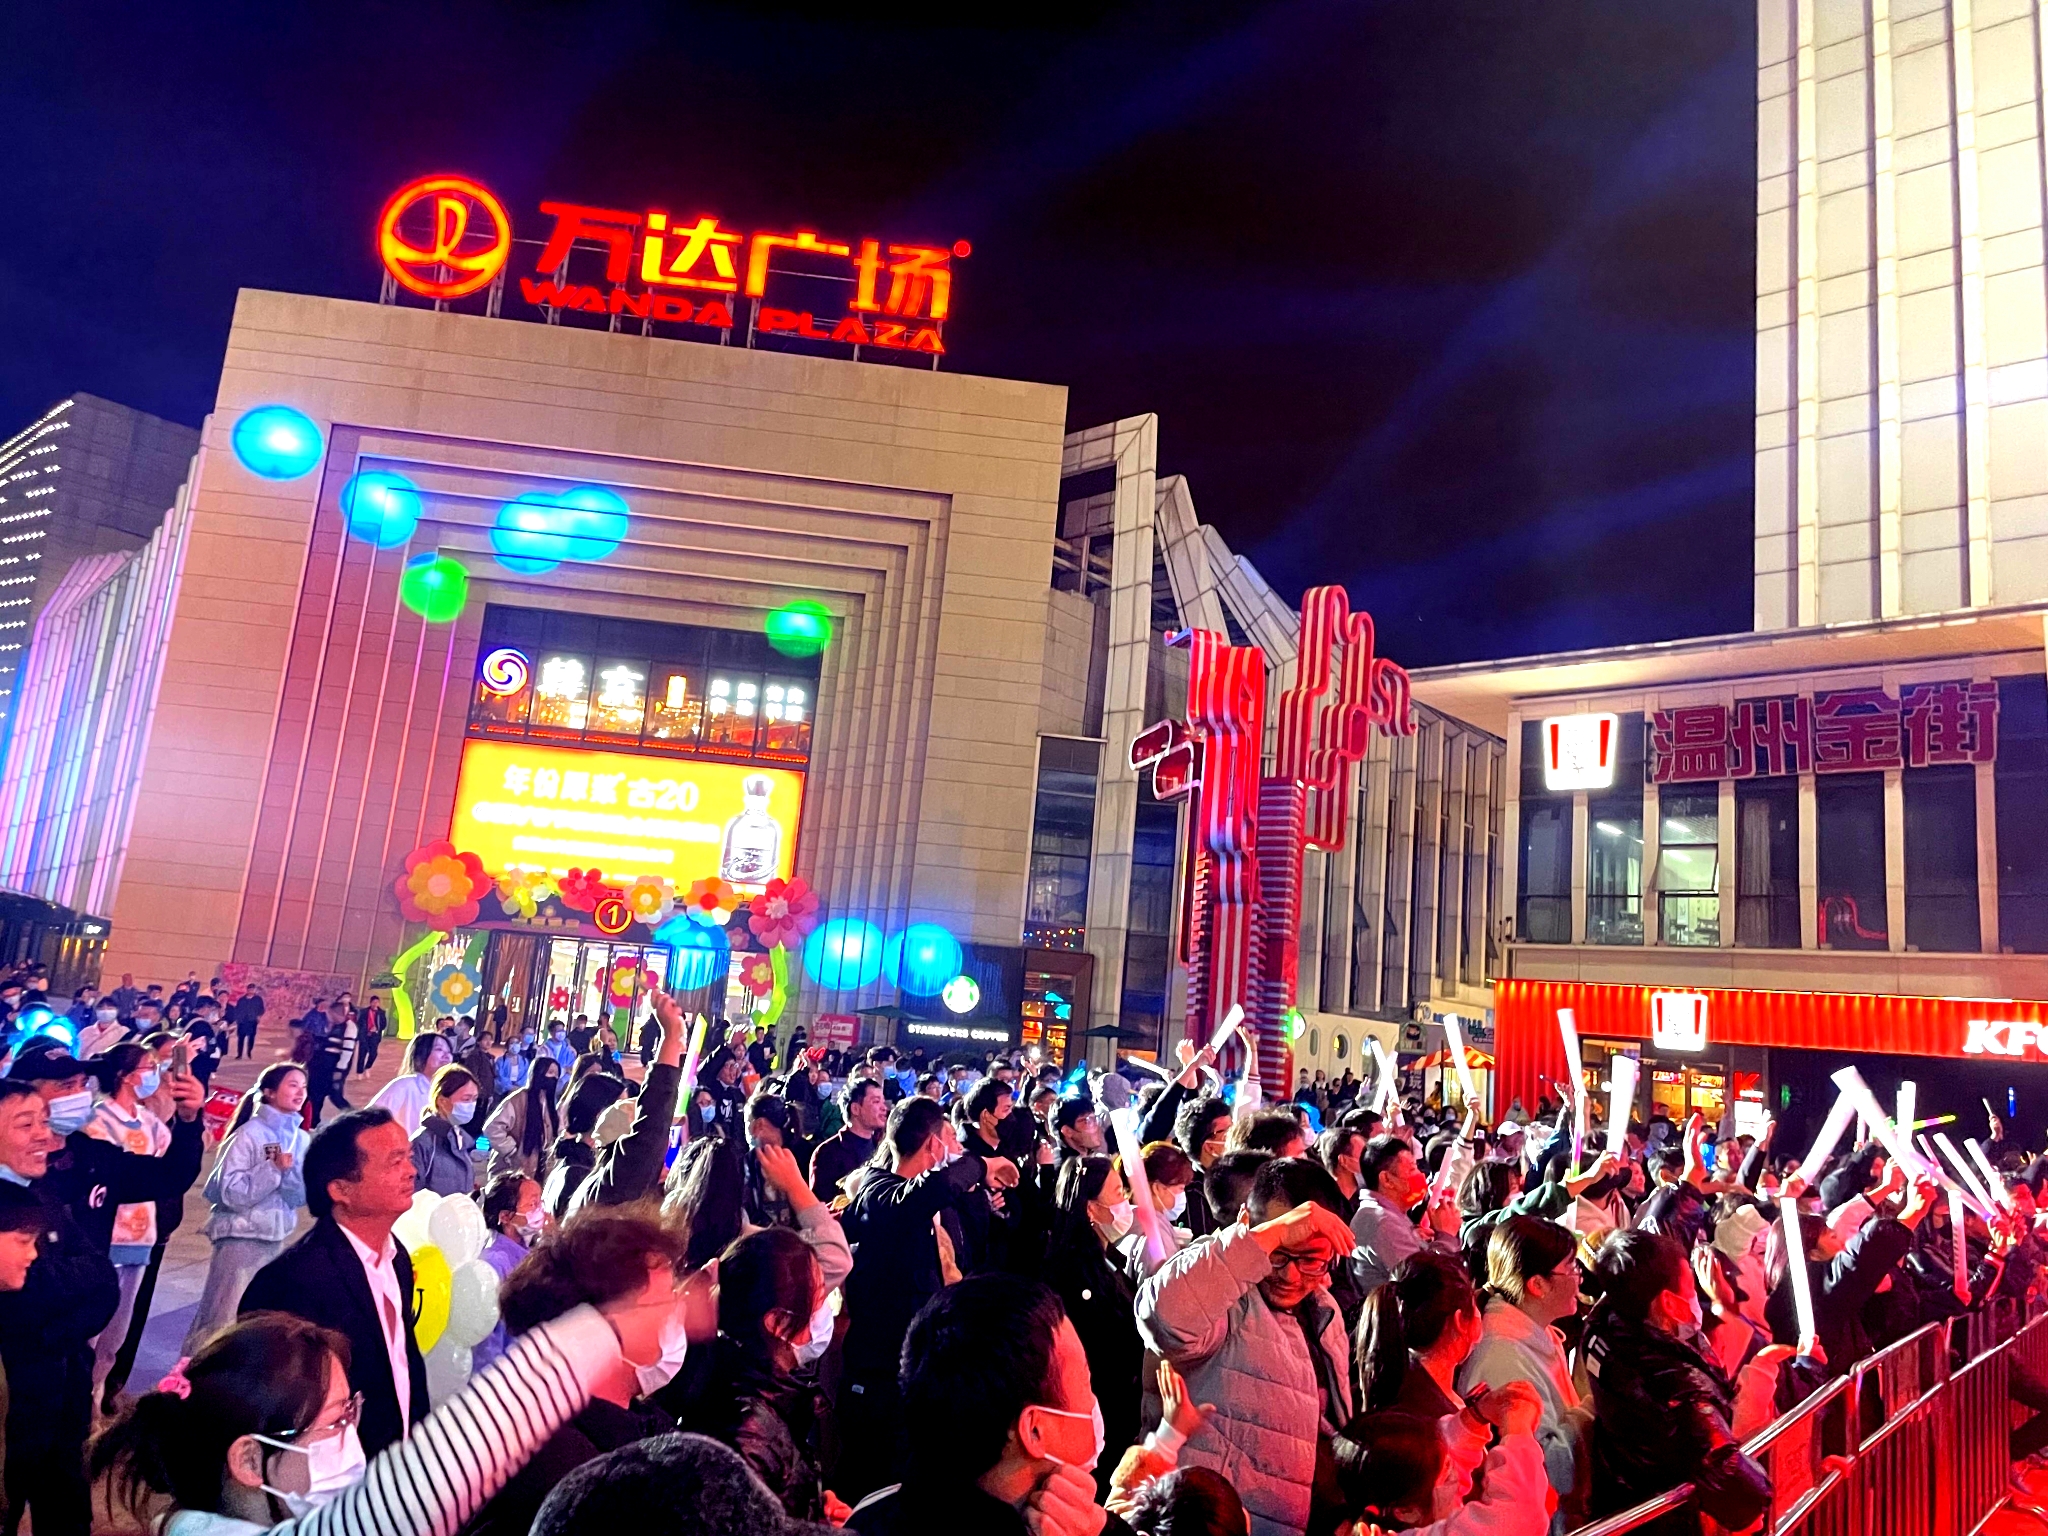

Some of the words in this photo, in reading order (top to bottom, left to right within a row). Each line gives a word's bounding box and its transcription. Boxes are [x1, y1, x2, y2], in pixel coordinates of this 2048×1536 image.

[539, 201, 951, 319] 万达广场
[520, 278, 735, 327] WANDA
[758, 307, 946, 354] PLAZA
[1651, 681, 1999, 784] 温州金街
[907, 1023, 969, 1039] STARBUCKS
[970, 1029, 1009, 1042] COFFEE
